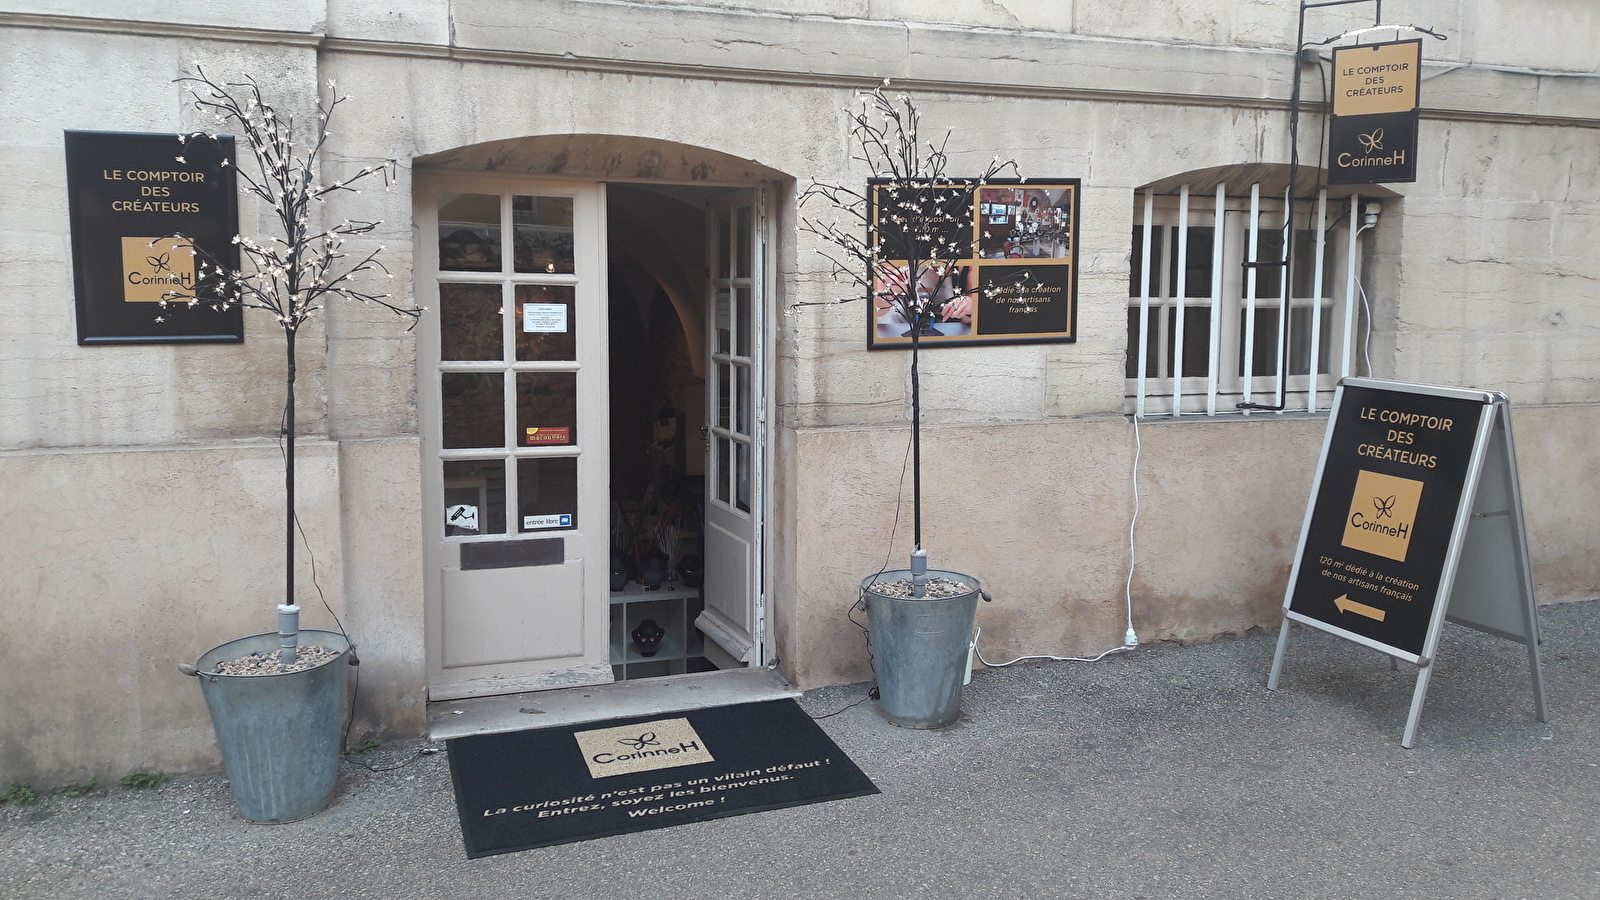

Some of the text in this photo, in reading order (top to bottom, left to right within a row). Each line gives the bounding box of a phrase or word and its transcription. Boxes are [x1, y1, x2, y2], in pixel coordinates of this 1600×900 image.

[1342, 62, 1409, 76] LE COMPTOIR
[1365, 76, 1384, 85] DES
[1346, 86, 1404, 98] CRÉATEURS
[1338, 150, 1405, 168] CorinneH
[104, 170, 205, 183] LE COMPTOIR
[141, 186, 170, 197] DES
[112, 199, 200, 213] CRÉATEURS
[128, 272, 191, 285] CorinneH
[1360, 407, 1453, 432] LE COMPTOIR
[1386, 430, 1414, 445] DES
[1357, 443, 1437, 469] CRÉATEURS
[1351, 512, 1409, 540] CorinneH
[1319, 556, 1333, 566] 120
[1346, 564, 1367, 576] dédié
[1375, 572, 1384, 580] la
[1385, 577, 1420, 591] création
[1322, 569, 1413, 602] de nos artisans français
[592, 739, 700, 765] CorinneH
[483, 806, 507, 817] La
[512, 793, 595, 813] curiosité
[650, 780, 683, 794] pas
[687, 777, 708, 786] un
[714, 767, 761, 782] vilain
[766, 759, 822, 774] défaut
[537, 773, 794, 819] Entrez, soyez les bienvenus.
[628, 798, 715, 818] Welcome
